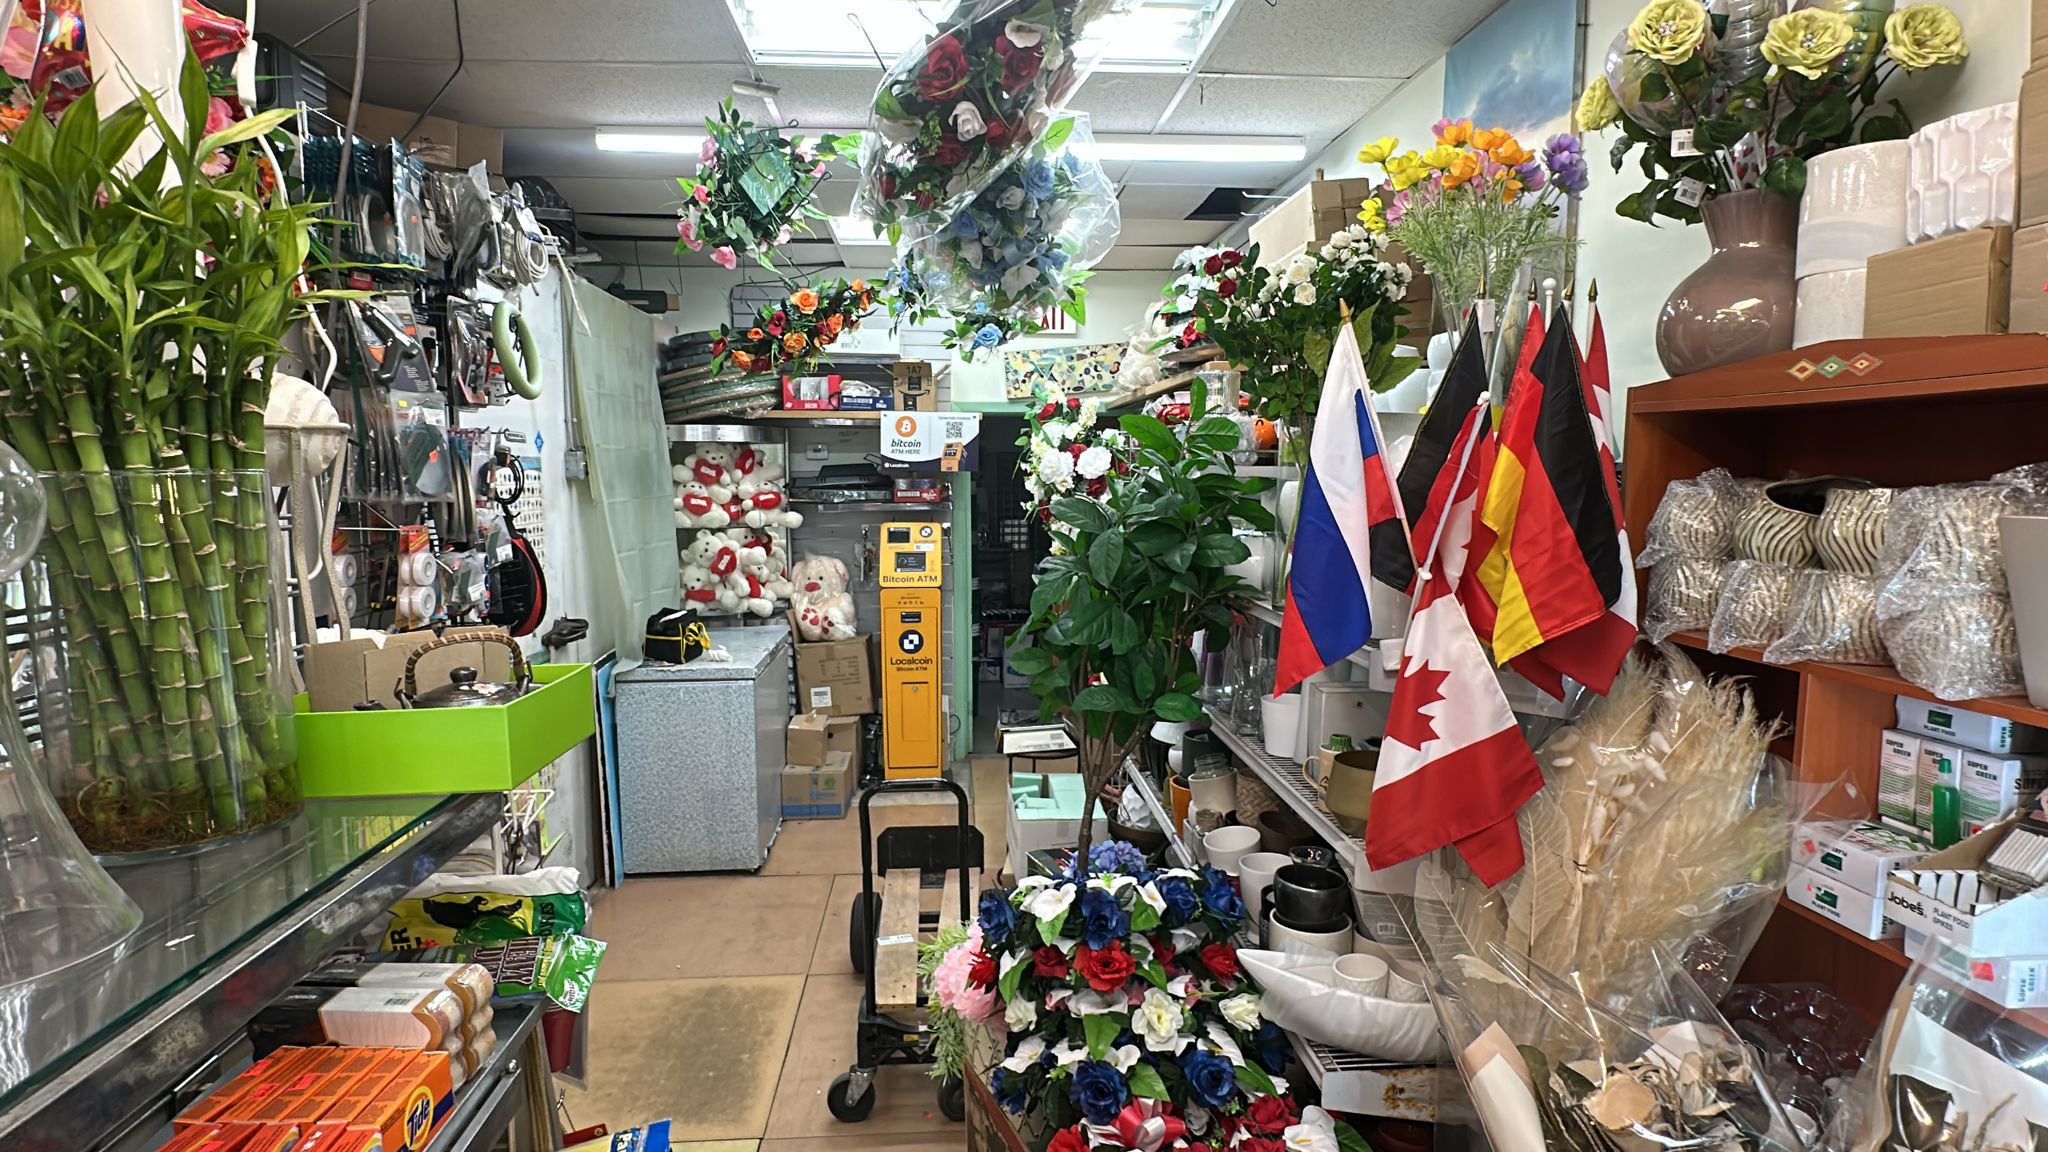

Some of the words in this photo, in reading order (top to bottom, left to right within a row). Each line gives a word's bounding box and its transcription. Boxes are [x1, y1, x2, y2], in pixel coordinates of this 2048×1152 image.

[891, 439, 921, 448] bitcoin
[882, 575, 915, 583] Bitcoin
[917, 575, 938, 583] ATM
[890, 657, 933, 666] Localcoin
[1886, 739, 1904, 748] SUPER
[1893, 748, 1911, 757] GREEN
[1925, 749, 1944, 758] SUPER
[1967, 760, 1988, 771] SUPER
[1976, 770, 1997, 781] GREEN
[1887, 891, 1924, 916] Jobe's
[1933, 907, 1953, 920] PLANT
[1953, 916, 1970, 929] FOOD
[1932, 917, 1953, 931] SPIKES
[407, 1098, 431, 1148] Tide
